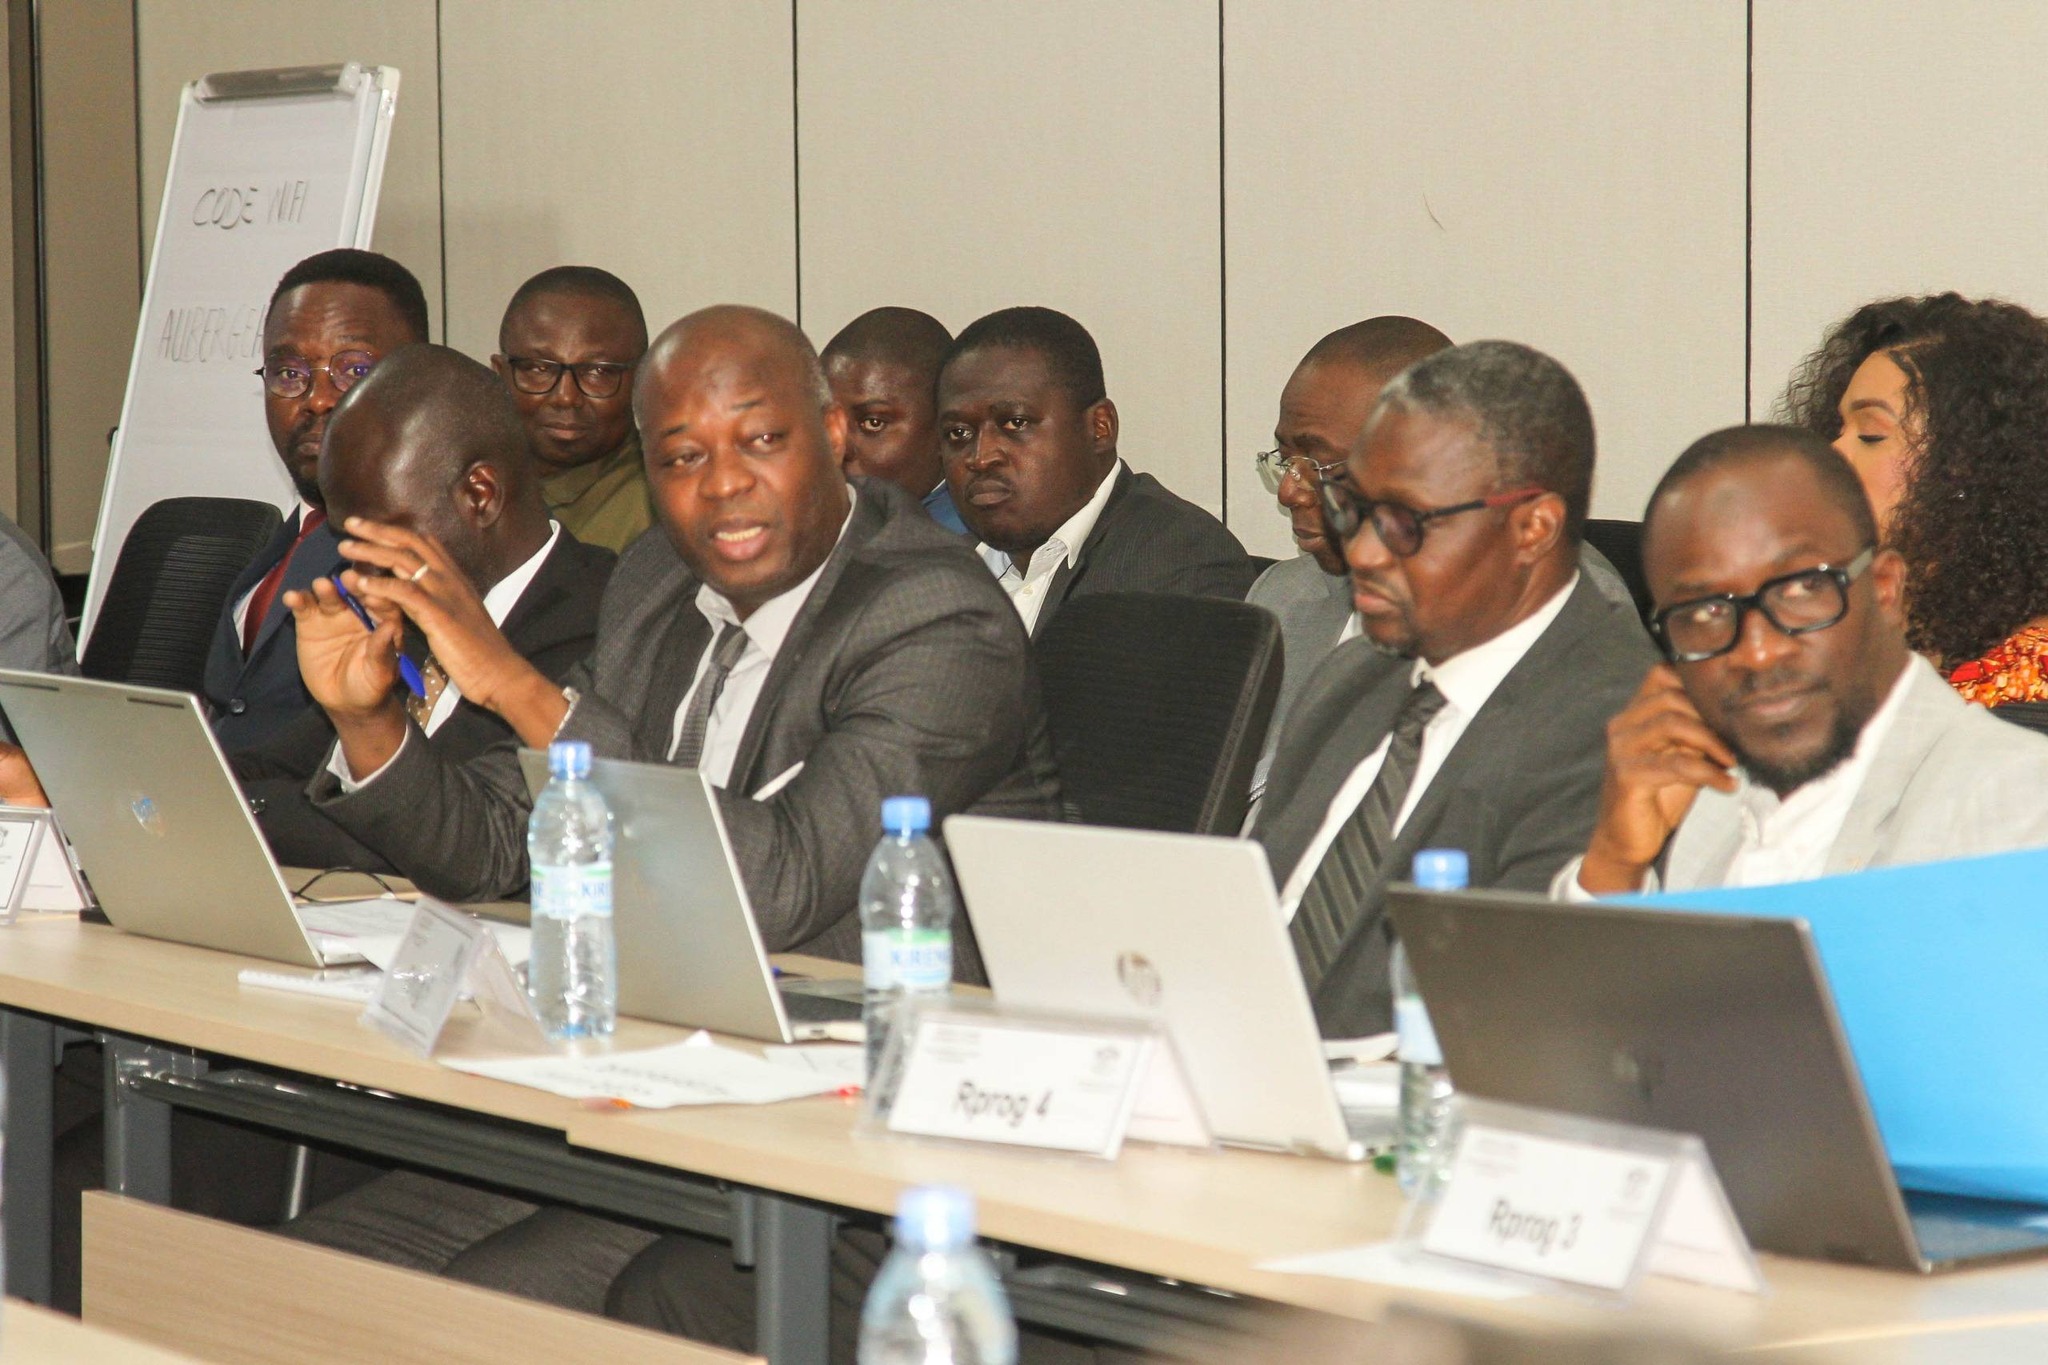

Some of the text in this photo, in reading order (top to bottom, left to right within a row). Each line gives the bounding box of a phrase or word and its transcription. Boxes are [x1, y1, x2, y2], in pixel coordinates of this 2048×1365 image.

[192, 186, 260, 230] CODE
[953, 1080, 1028, 1127] Rprog
[1488, 1197, 1583, 1256] Rprog 3
